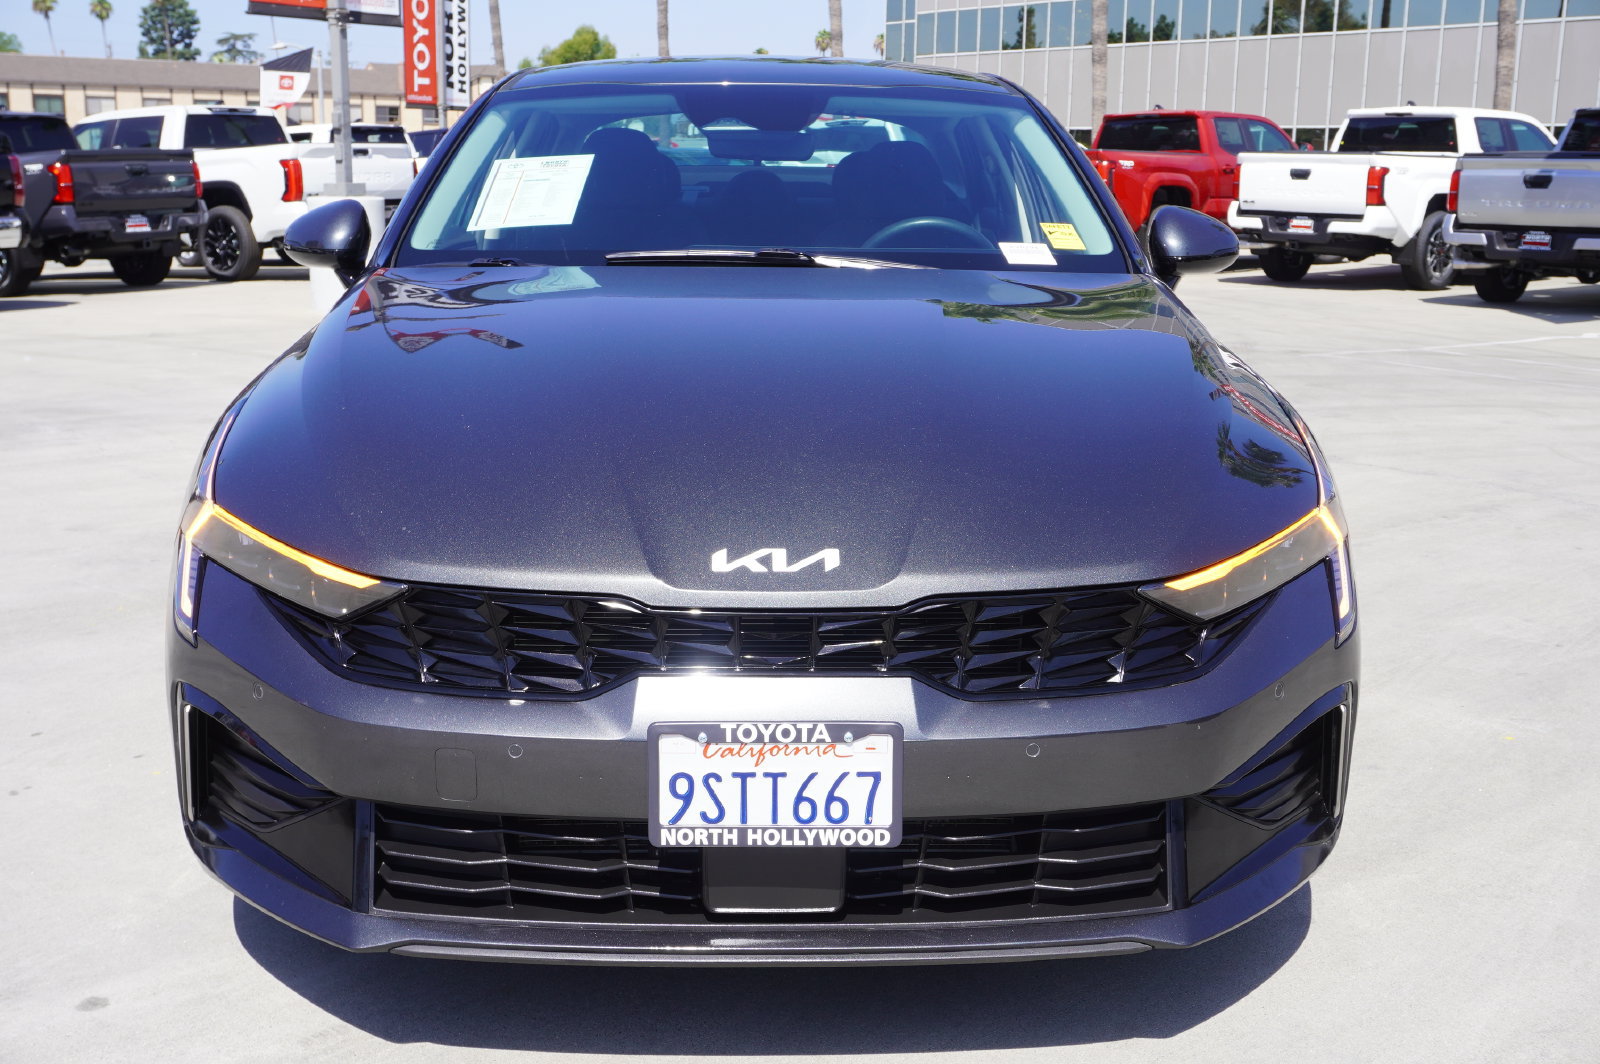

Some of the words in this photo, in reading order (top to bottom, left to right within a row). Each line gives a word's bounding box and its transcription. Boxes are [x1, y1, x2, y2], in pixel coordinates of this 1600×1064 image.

[458, 0, 467, 93] HOLLYW
[712, 548, 840, 572] KIA
[720, 724, 831, 743] TOYOTA
[703, 743, 853, 767] California
[669, 772, 881, 825] 9STT667
[660, 829, 738, 846] NORTH
[747, 829, 891, 846] HOLLYWOOD
